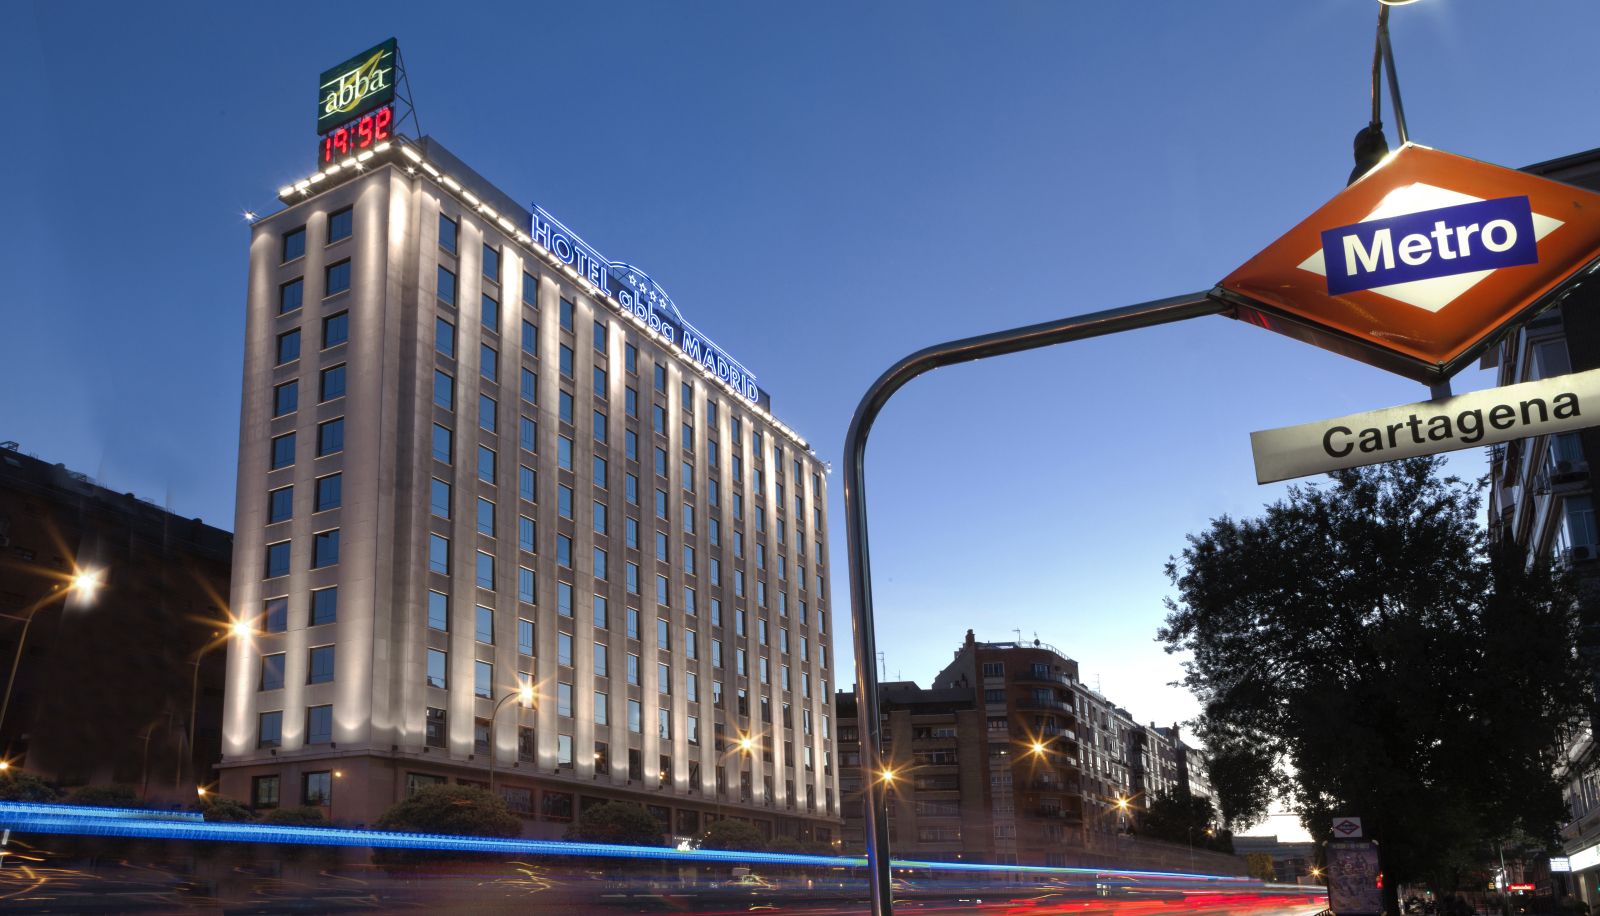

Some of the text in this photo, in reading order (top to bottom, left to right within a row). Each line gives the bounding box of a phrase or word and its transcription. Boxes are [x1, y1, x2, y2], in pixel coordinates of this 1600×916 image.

[325, 69, 384, 113] abba
[1342, 218, 1518, 276] Metro
[532, 214, 758, 403] HOTEL abba MADRID
[1322, 392, 1581, 458] Cartagena
